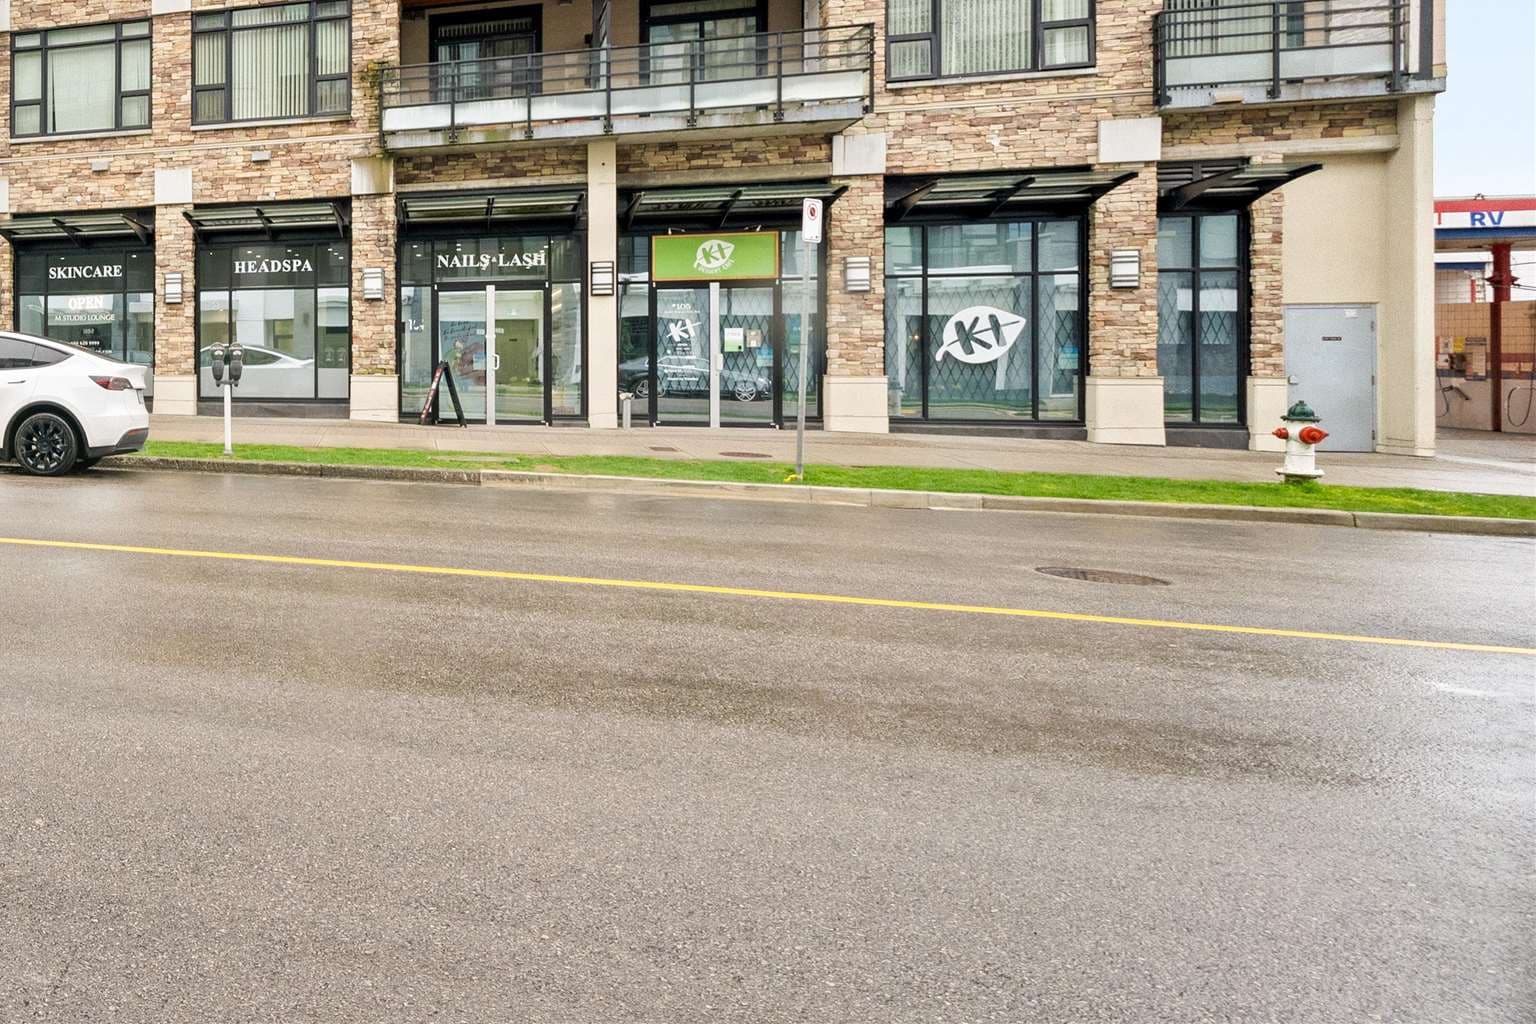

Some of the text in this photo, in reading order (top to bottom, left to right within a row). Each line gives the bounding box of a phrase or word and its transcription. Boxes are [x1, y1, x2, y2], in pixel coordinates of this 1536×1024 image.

[1469, 210, 1504, 226] RV
[234, 258, 313, 273] HEADSPA
[437, 254, 490, 269] NAILS
[498, 252, 546, 267] LASH
[48, 265, 122, 279] SKINCARE
[68, 296, 104, 310] OPEN
[87, 313, 115, 321] LOUNGE
